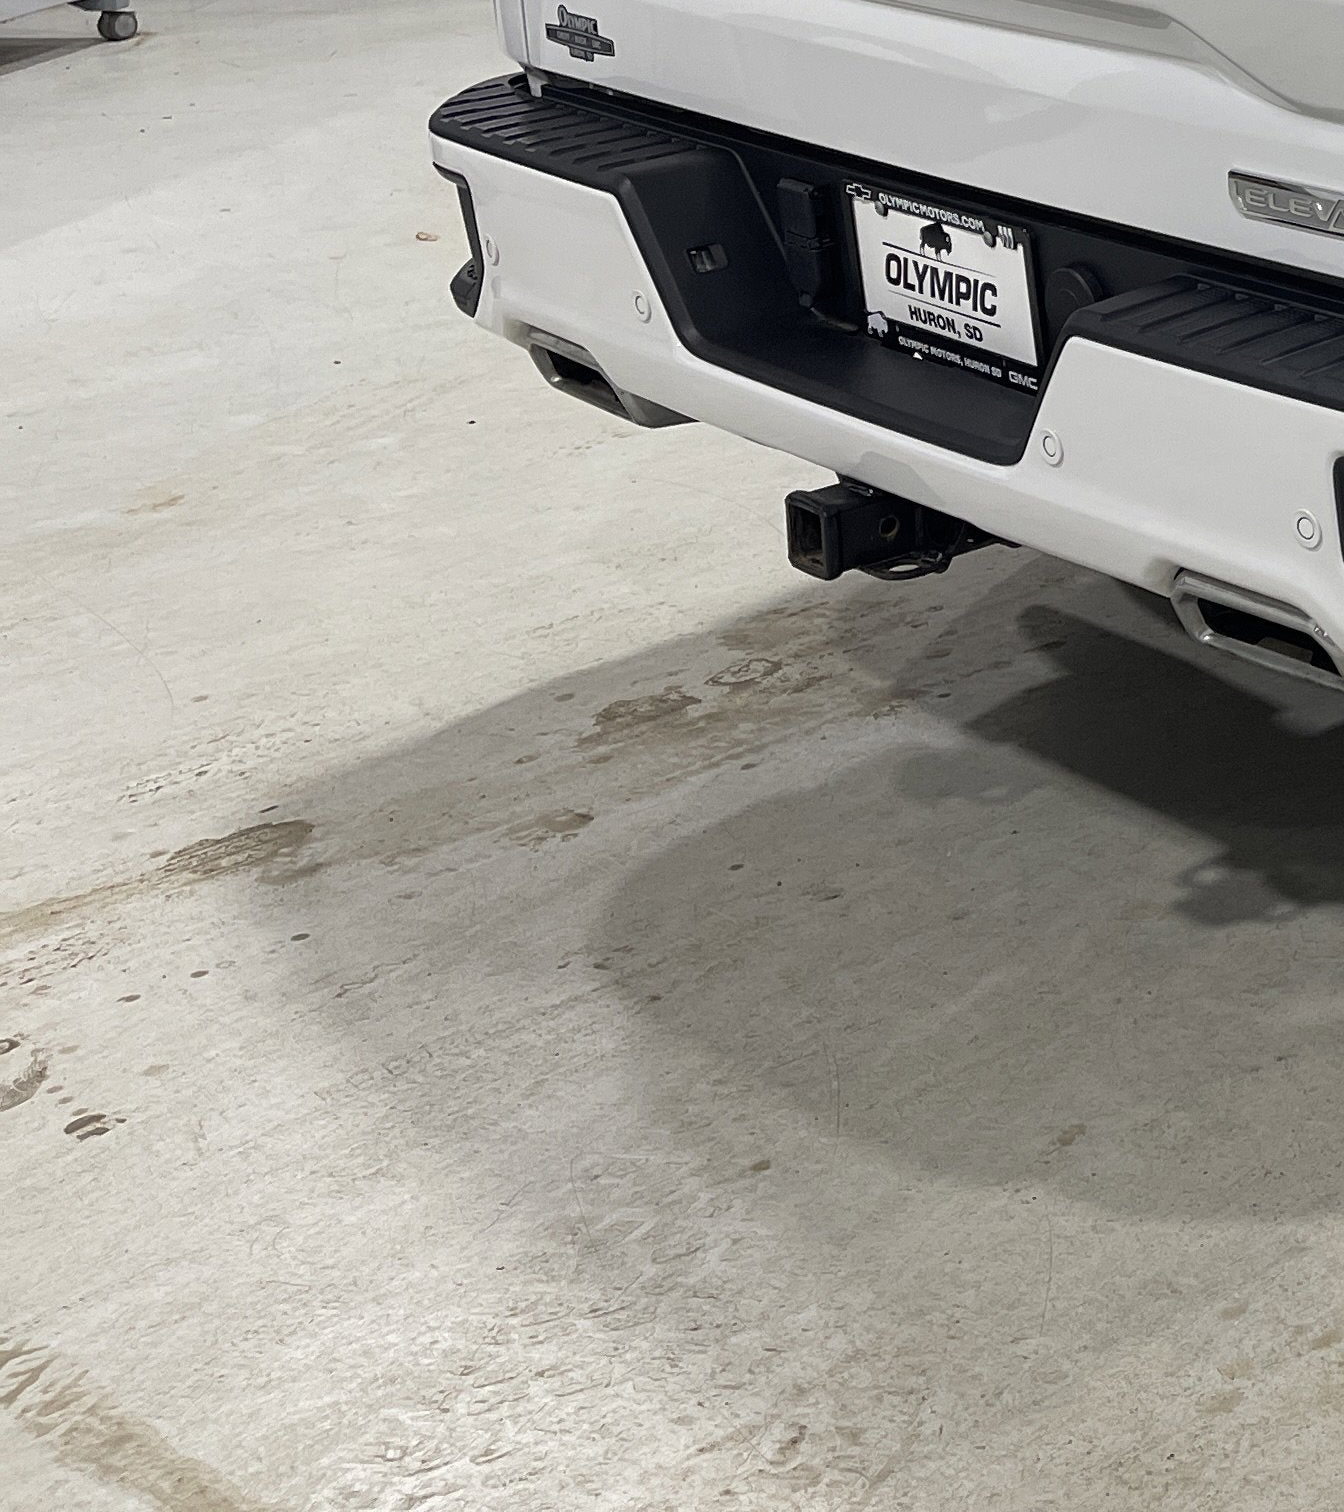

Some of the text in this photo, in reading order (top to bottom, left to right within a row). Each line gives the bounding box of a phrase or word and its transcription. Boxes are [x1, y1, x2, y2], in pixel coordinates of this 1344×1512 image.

[885, 253, 998, 317] OLYMPIC
[908, 304, 984, 343] HURON, SD
[1008, 370, 1038, 391] GMC
